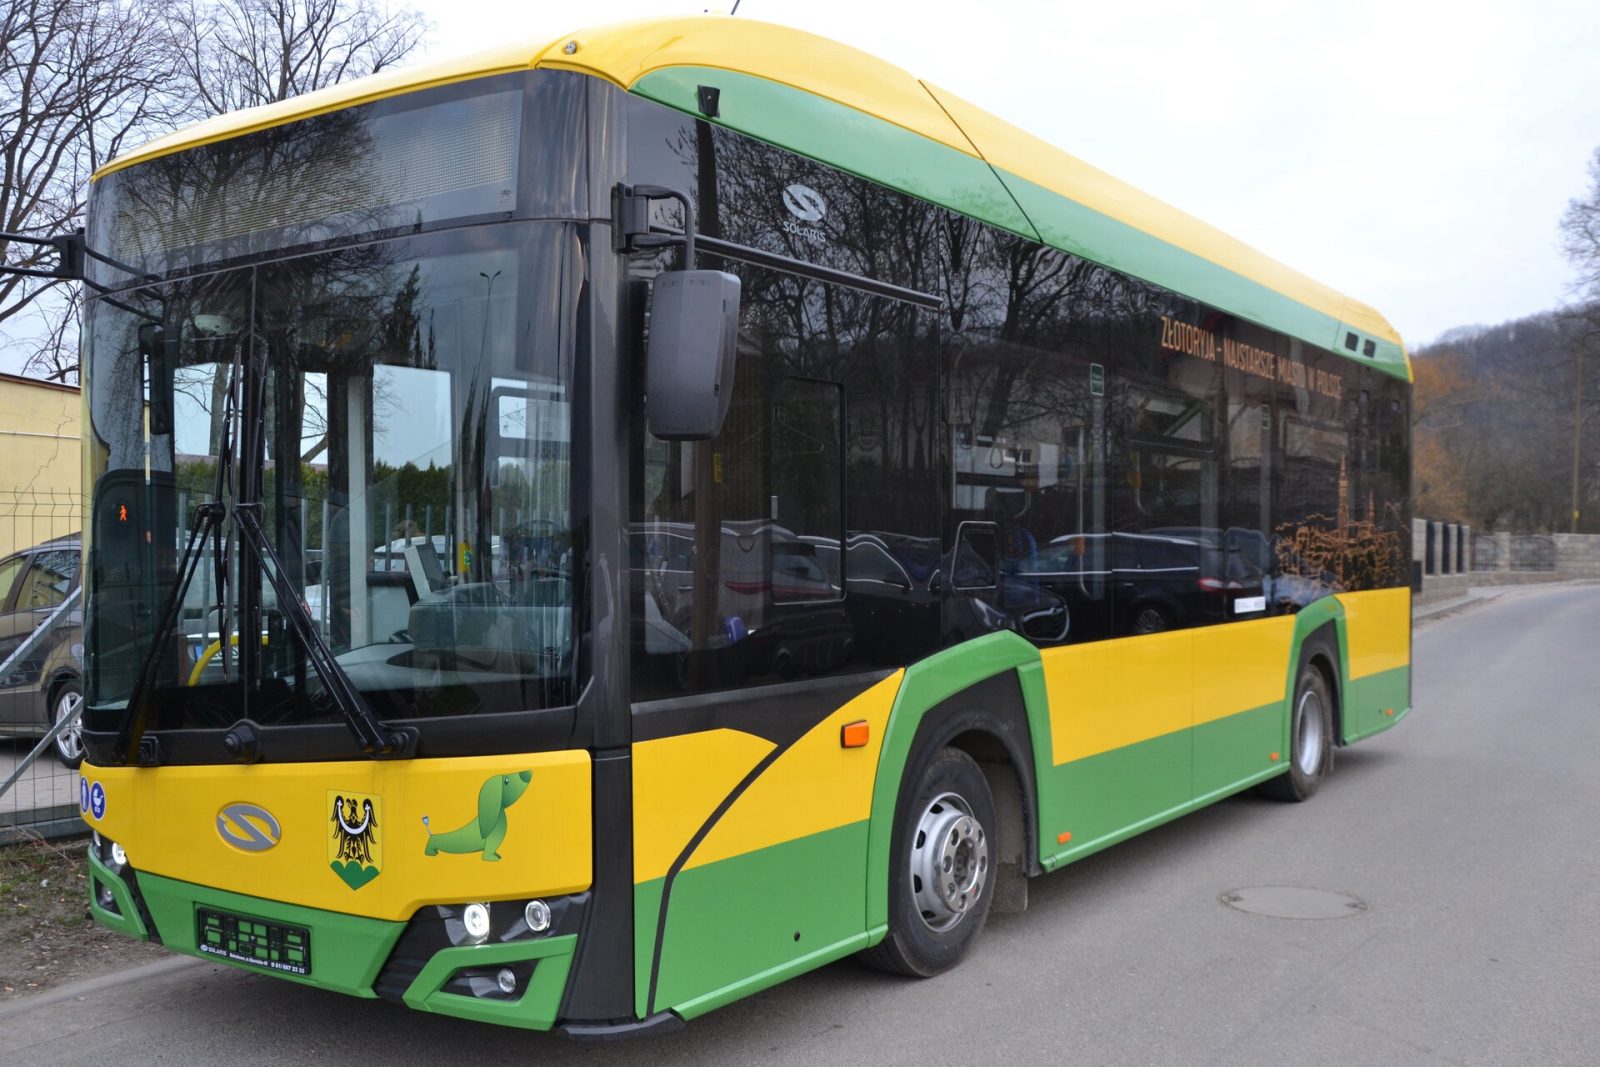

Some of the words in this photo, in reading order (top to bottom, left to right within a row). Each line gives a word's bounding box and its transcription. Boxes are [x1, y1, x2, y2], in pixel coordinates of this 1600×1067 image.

[782, 221, 826, 242] SOLARIS
[1160, 316, 1216, 362] ZŁOTORYJA
[1223, 336, 1275, 380] NAJSTARSZE
[1278, 355, 1306, 388] MIASTO
[1307, 366, 1315, 391] W
[1316, 369, 1342, 400] POLSCE
